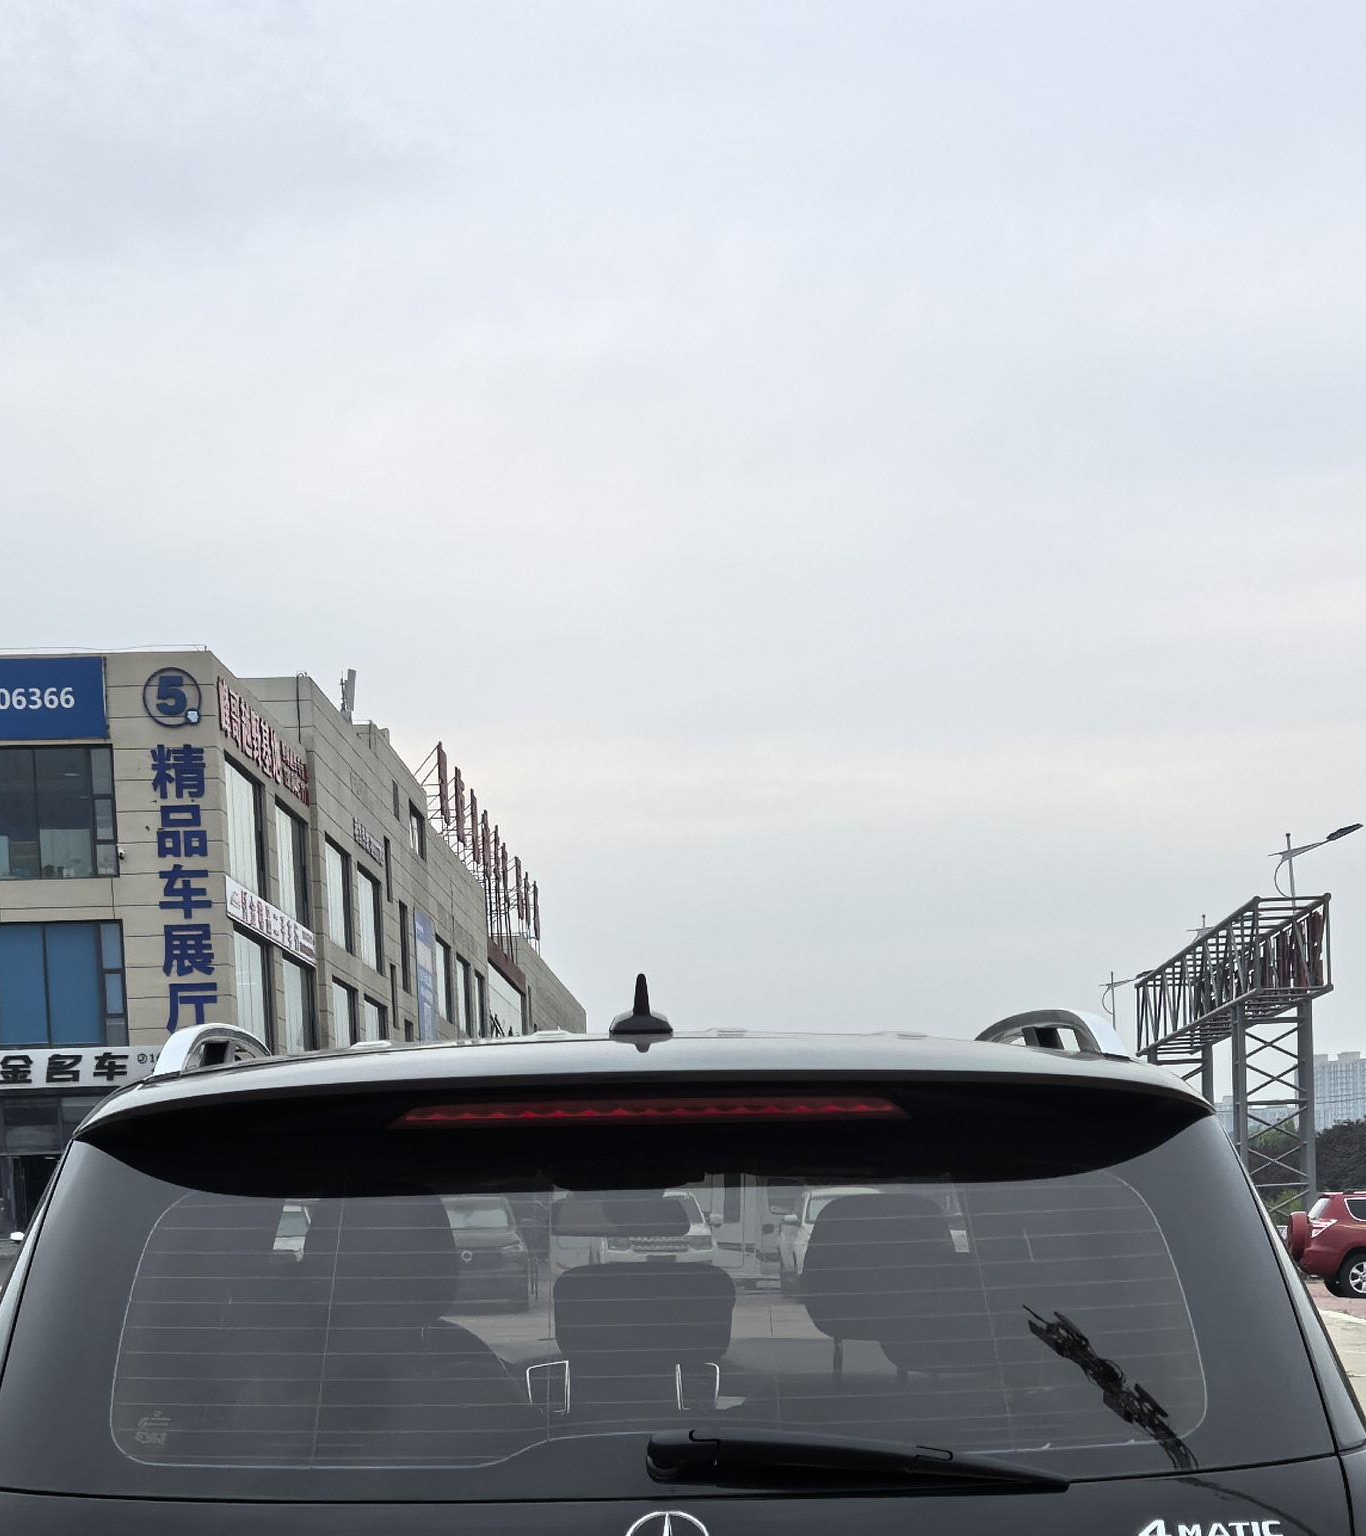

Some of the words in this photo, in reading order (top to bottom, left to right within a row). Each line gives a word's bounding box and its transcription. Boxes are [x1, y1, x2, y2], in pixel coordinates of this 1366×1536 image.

[156, 676, 187, 716] 5
[150, 744, 218, 1033] 精品车展厅
